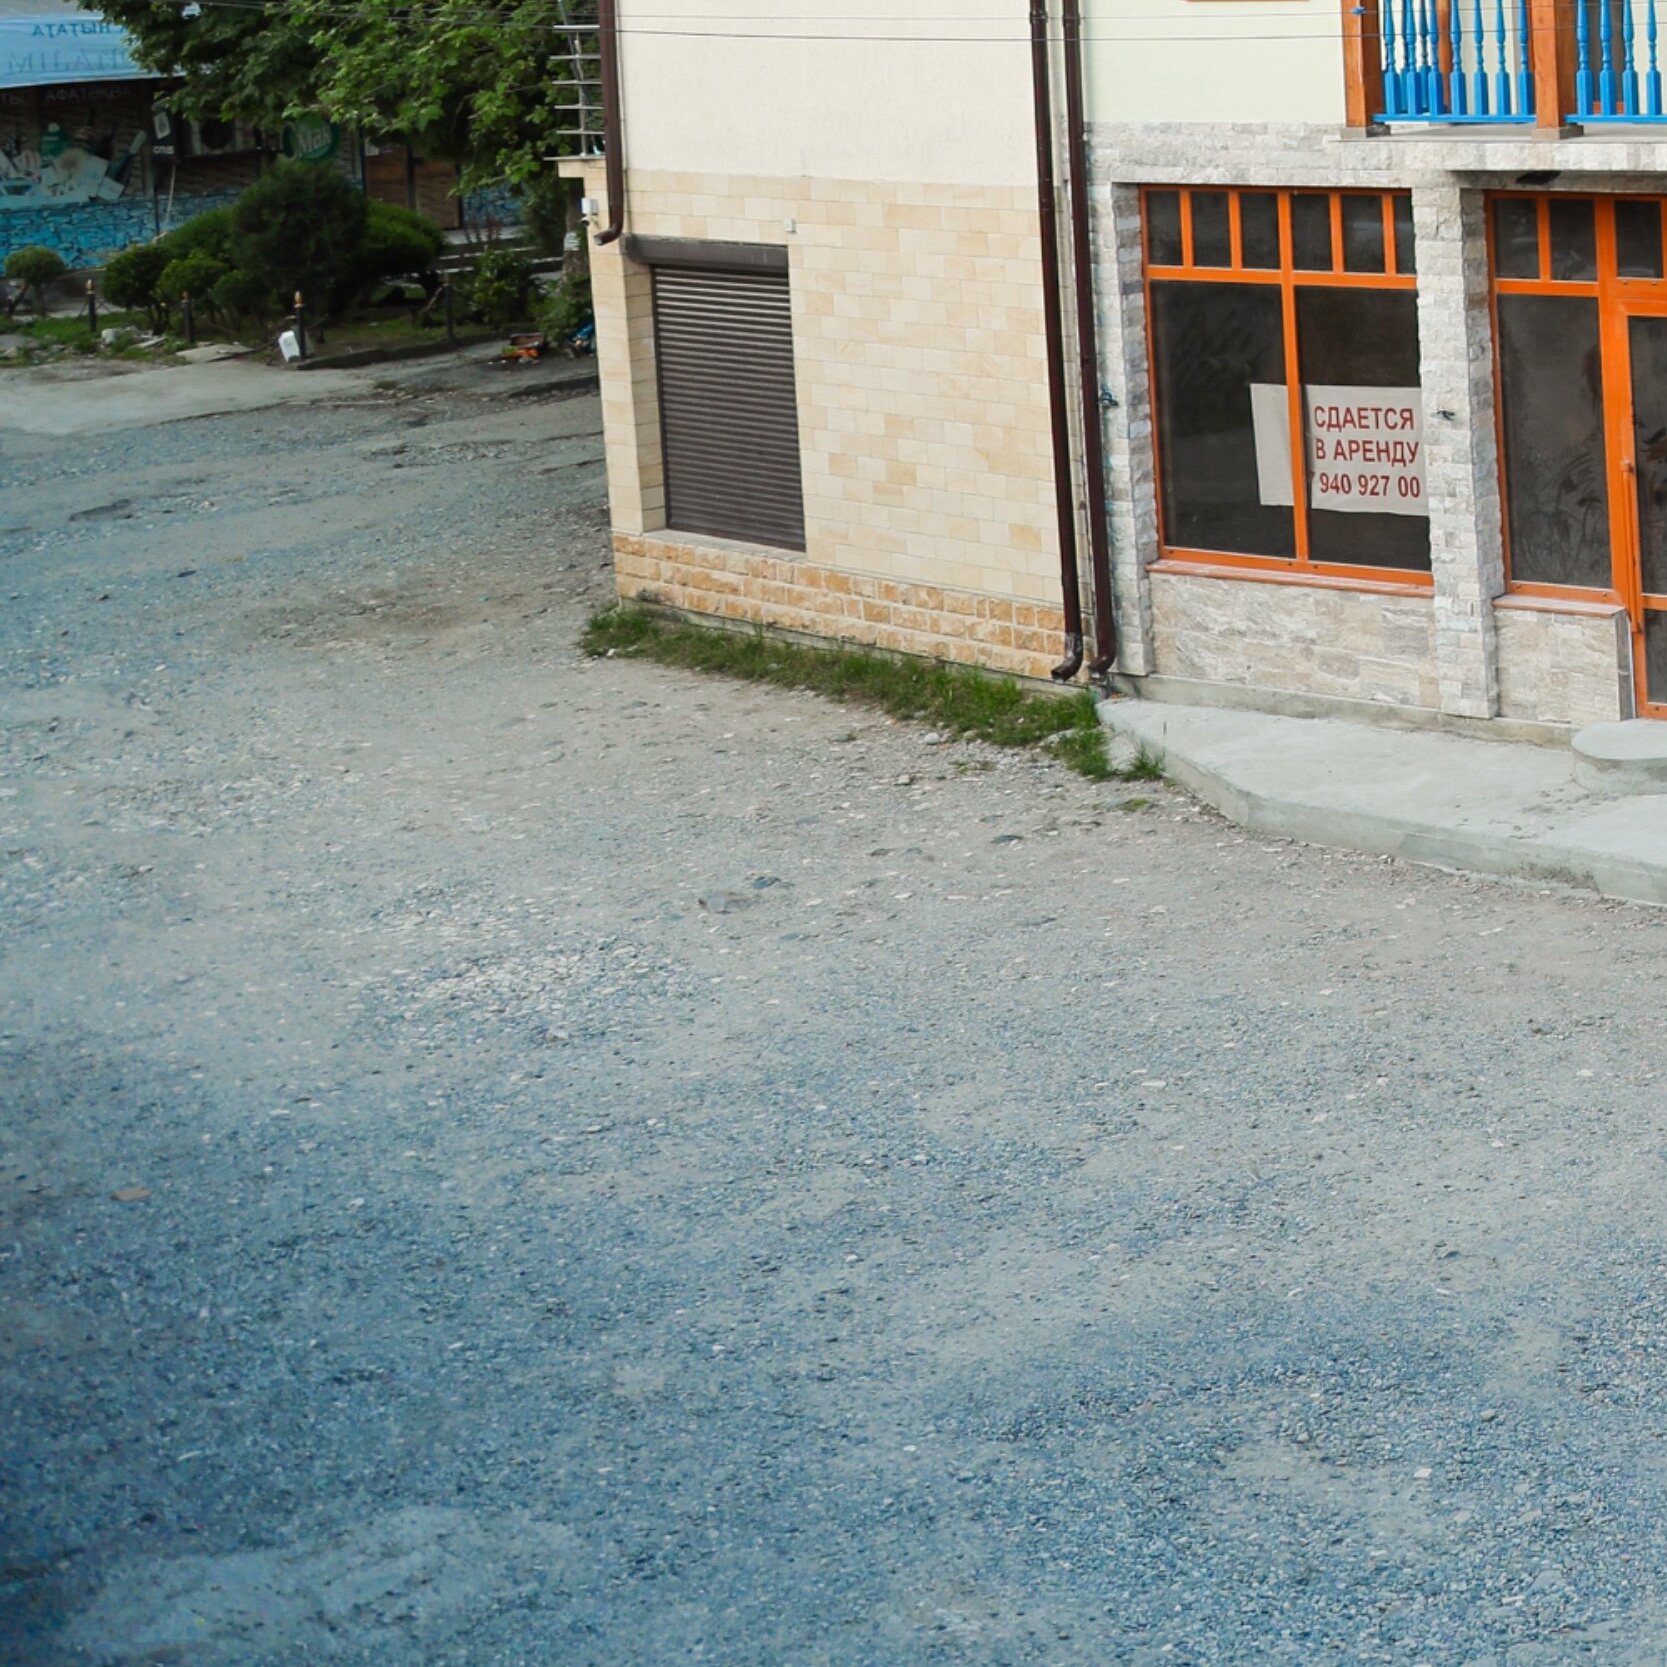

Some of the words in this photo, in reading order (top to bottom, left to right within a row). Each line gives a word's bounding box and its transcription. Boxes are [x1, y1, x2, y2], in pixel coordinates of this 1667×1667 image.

[1314, 406, 1414, 432] СДАЕТСЯ
[1316, 438, 1326, 460] В
[1333, 439, 1419, 466] АРЕНДУ
[1320, 473, 1351, 495] 940
[1358, 475, 1390, 497] 927
[1398, 476, 1421, 498] 00
